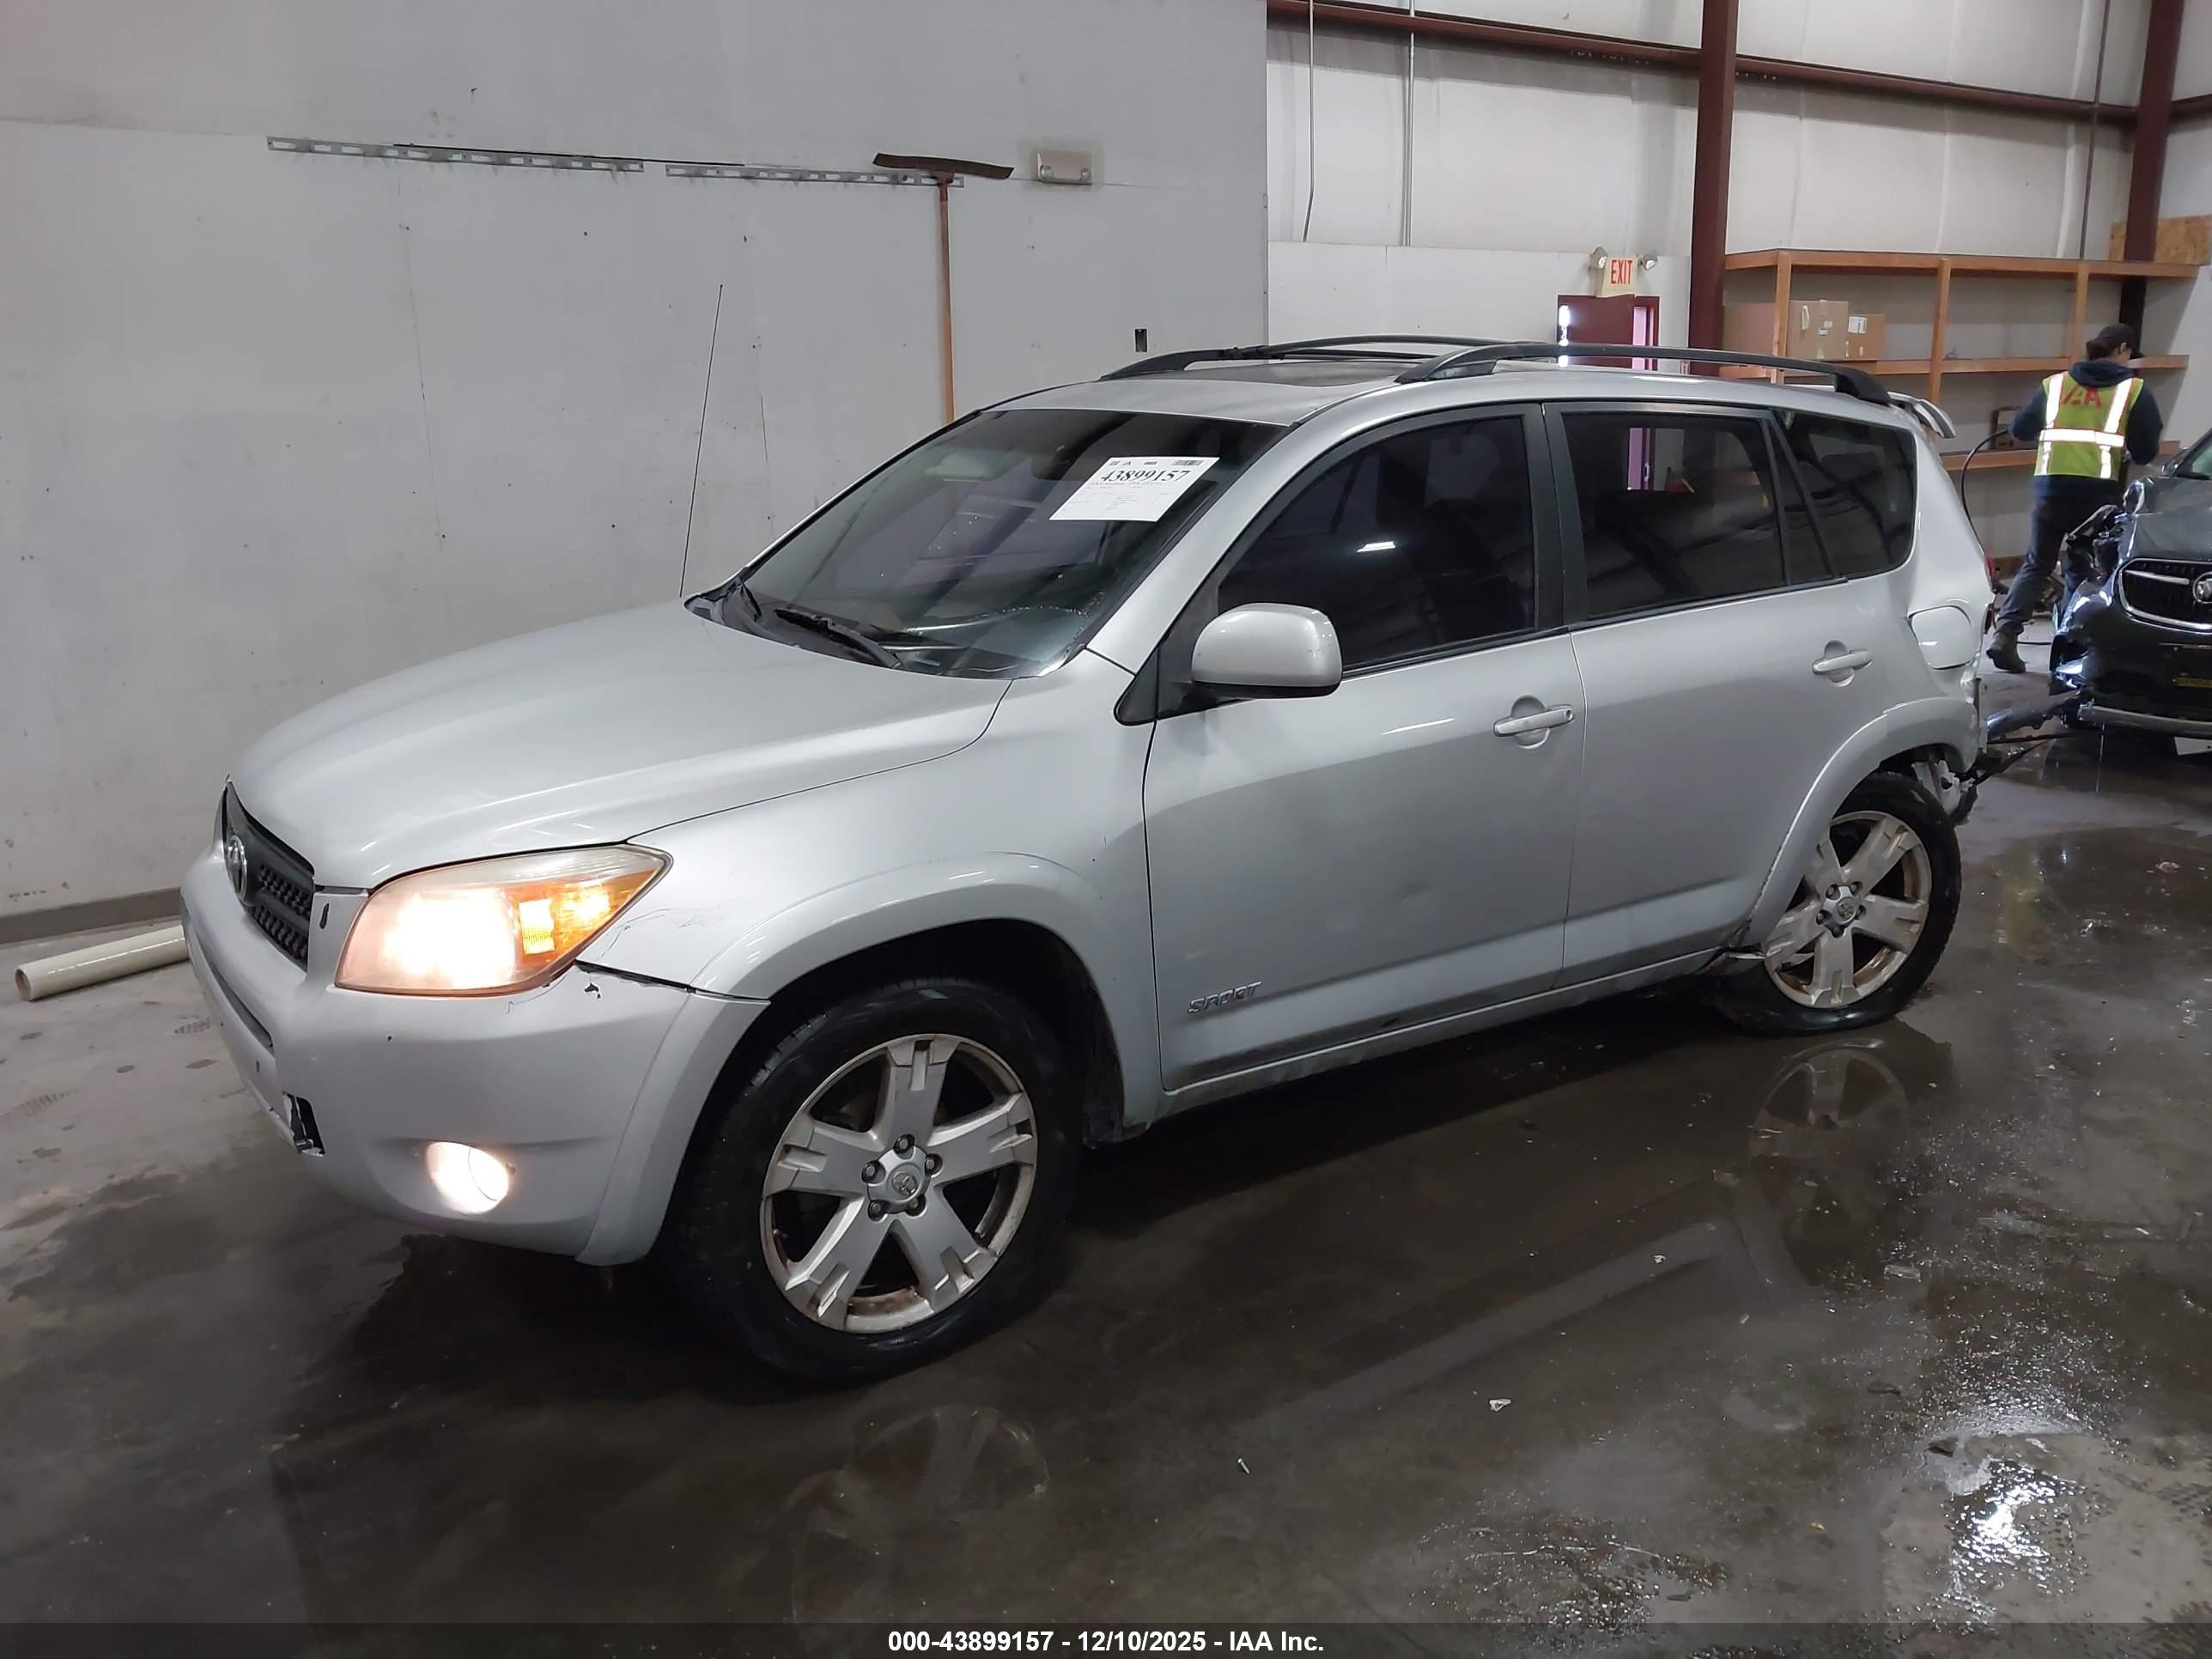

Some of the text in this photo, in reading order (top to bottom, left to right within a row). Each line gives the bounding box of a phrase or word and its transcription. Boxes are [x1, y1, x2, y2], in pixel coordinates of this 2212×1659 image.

[1610, 258, 1633, 285] EXIT
[1100, 469, 1193, 482] 43899157
[1187, 981, 1262, 1013] SPORT
